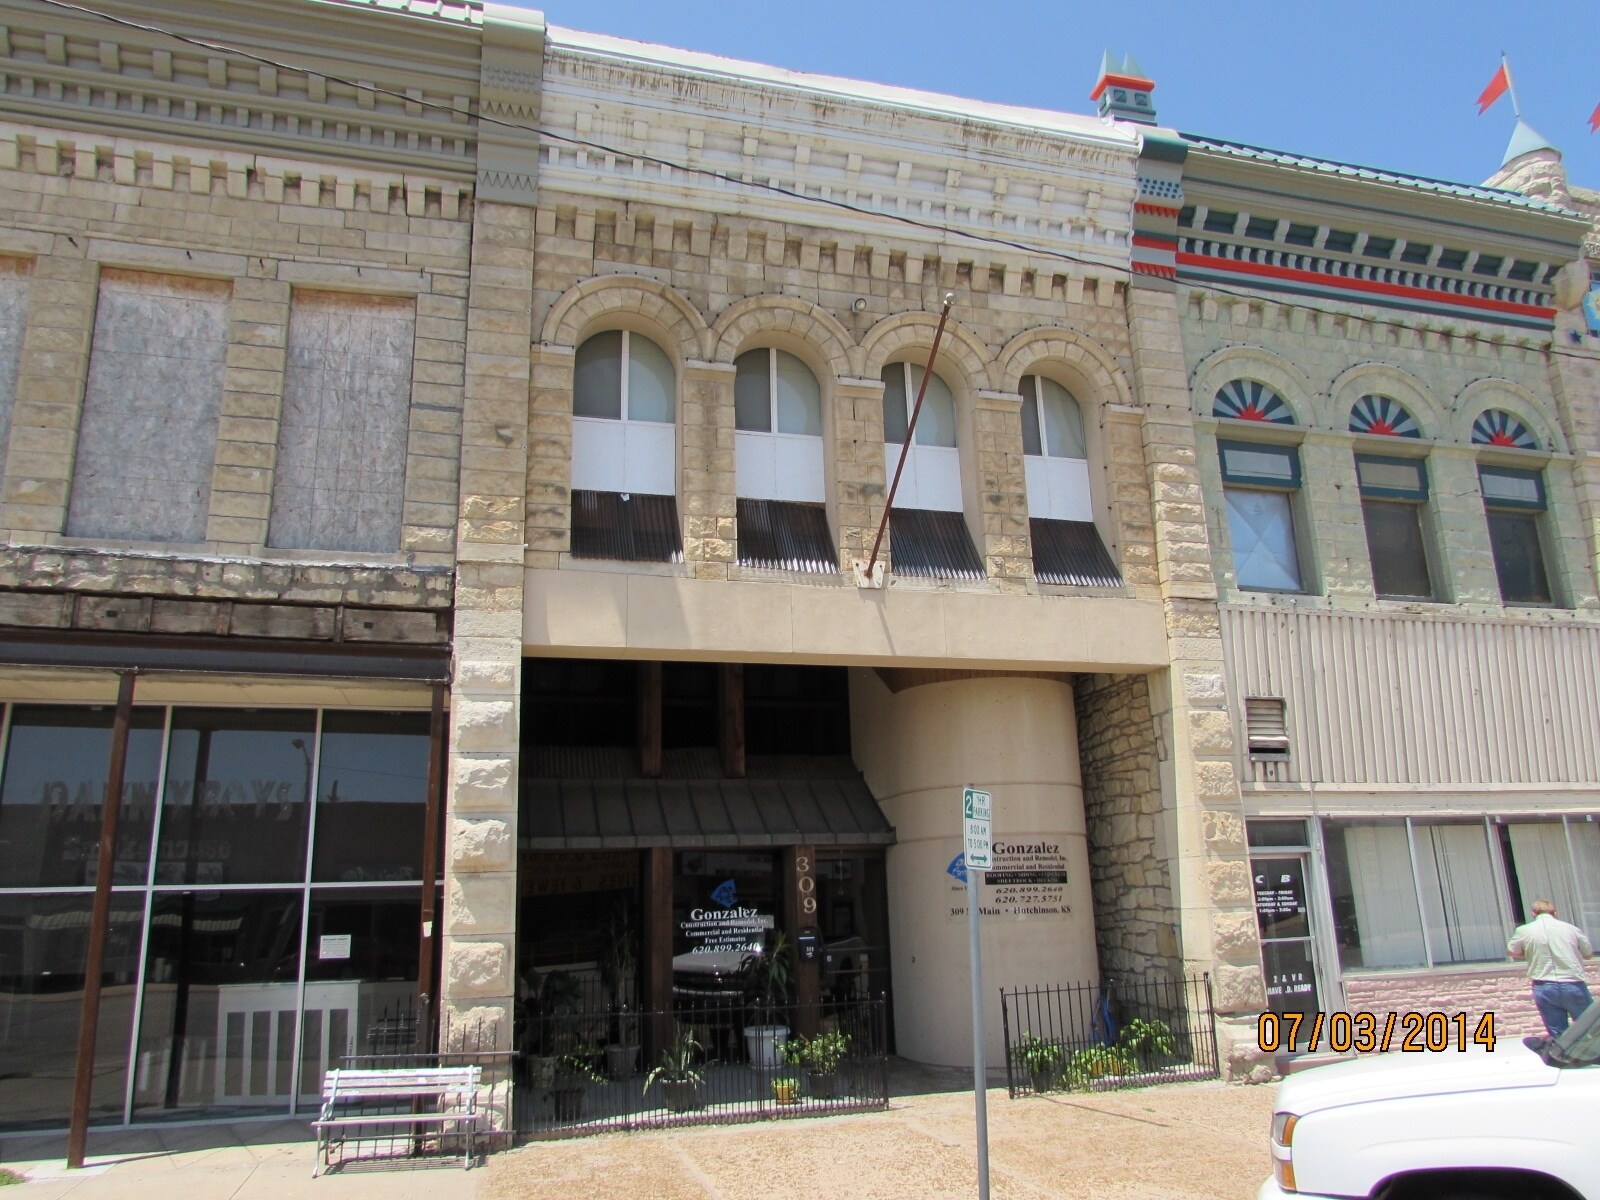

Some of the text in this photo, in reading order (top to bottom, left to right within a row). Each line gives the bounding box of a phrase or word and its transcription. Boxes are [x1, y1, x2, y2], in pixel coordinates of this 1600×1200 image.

[965, 796, 972, 814] 2
[976, 796, 986, 806] HR
[973, 806, 990, 818] PARKING
[980, 825, 986, 836] AM
[968, 838, 973, 848] TO
[983, 840, 988, 850] PM
[992, 842, 1060, 854] Gonzalez
[796, 856, 817, 914] 309
[995, 886, 1063, 894] 620.899.2640
[995, 895, 1062, 904] 620.727.5751
[690, 906, 758, 921] Gonzalez
[978, 906, 1000, 916] Main
[1014, 906, 1060, 915] Hutchinson,
[680, 920, 718, 928] Construction
[685, 929, 720, 937] Commercial
[692, 942, 760, 954] 620.899.2640
[1267, 986, 1282, 995] HAVE
[1293, 984, 1312, 992] READY
